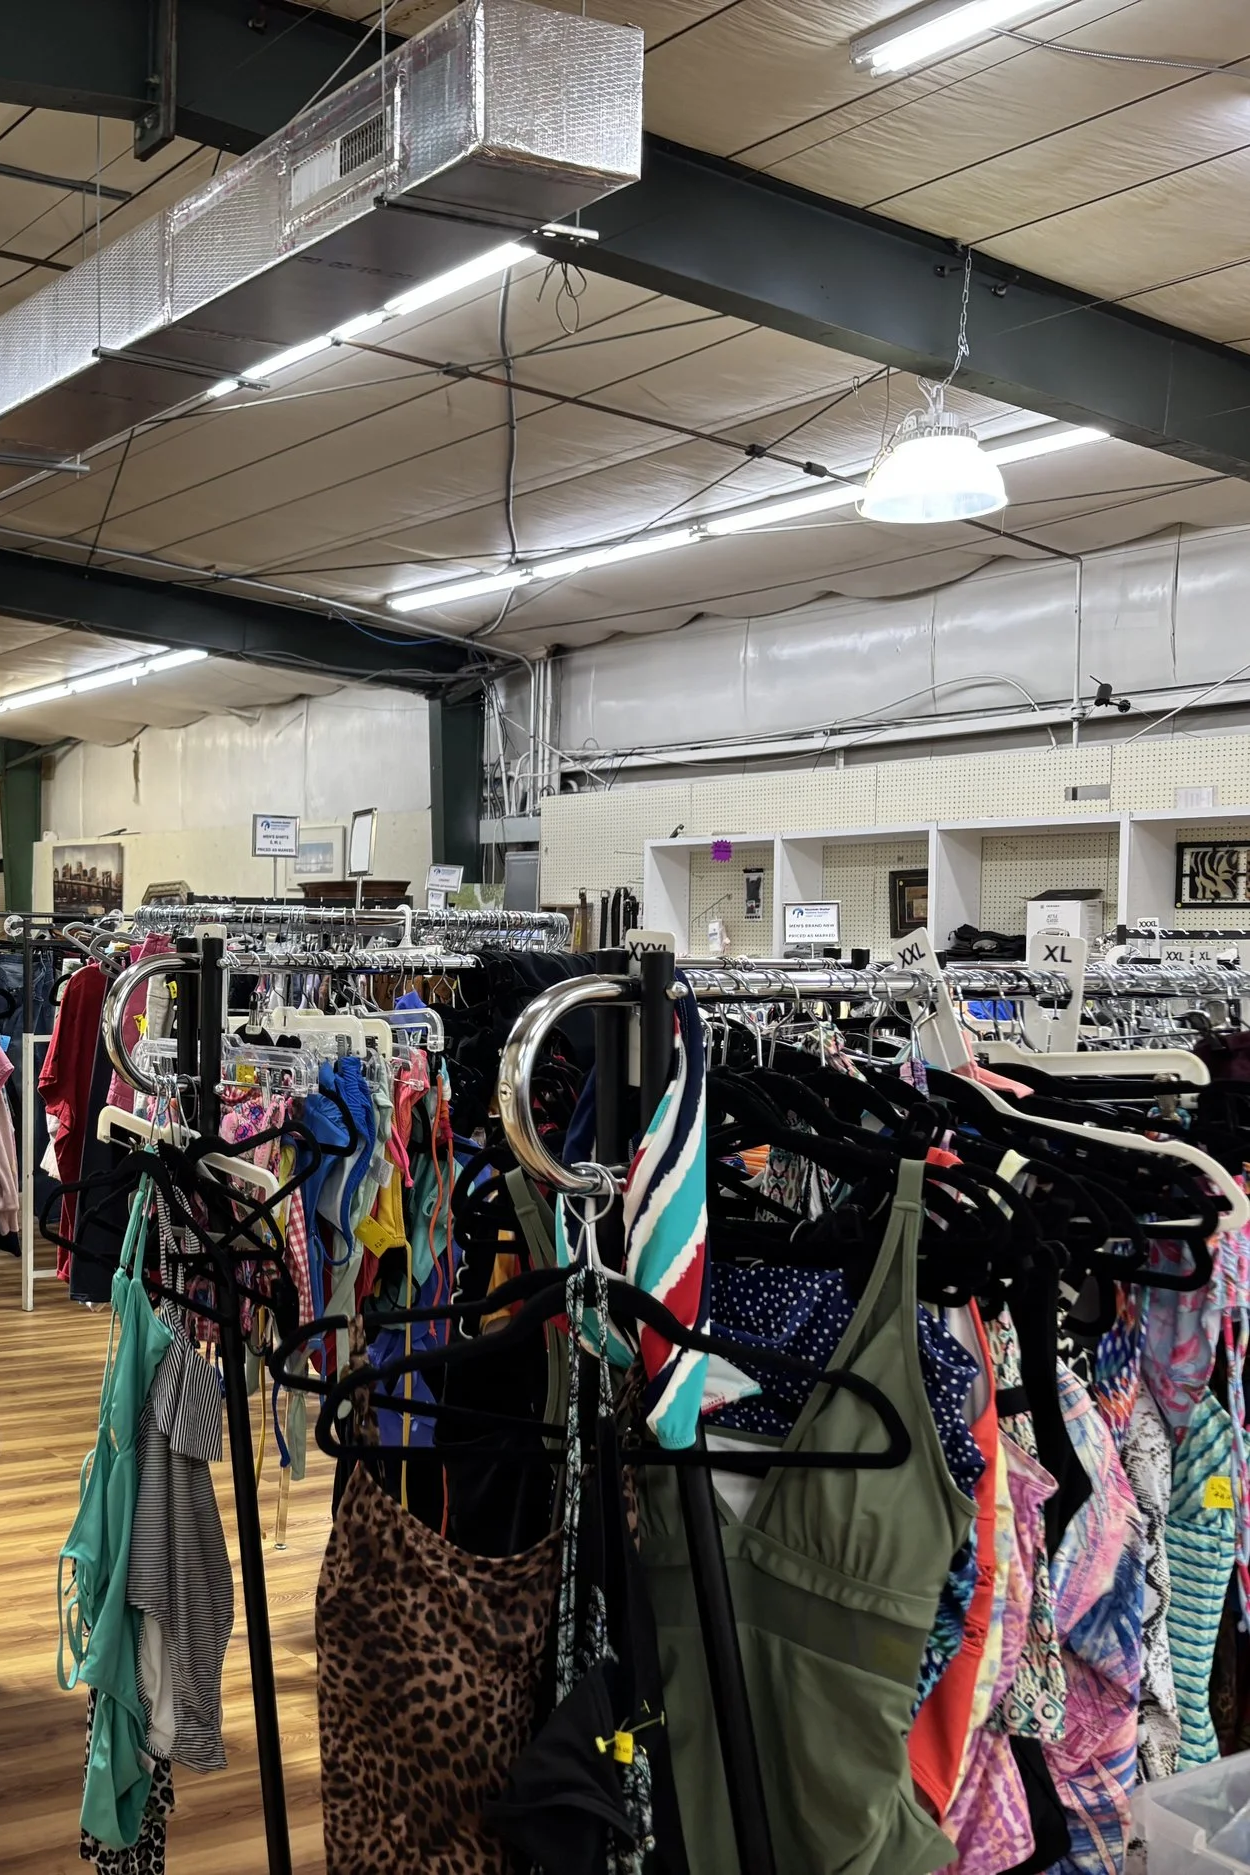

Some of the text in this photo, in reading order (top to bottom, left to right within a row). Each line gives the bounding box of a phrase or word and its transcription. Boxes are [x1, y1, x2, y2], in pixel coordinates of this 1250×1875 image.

[897, 942, 926, 969] XXL
[1043, 945, 1072, 963] XL
[1166, 951, 1185, 961] XXL
[1199, 952, 1211, 960] XL
